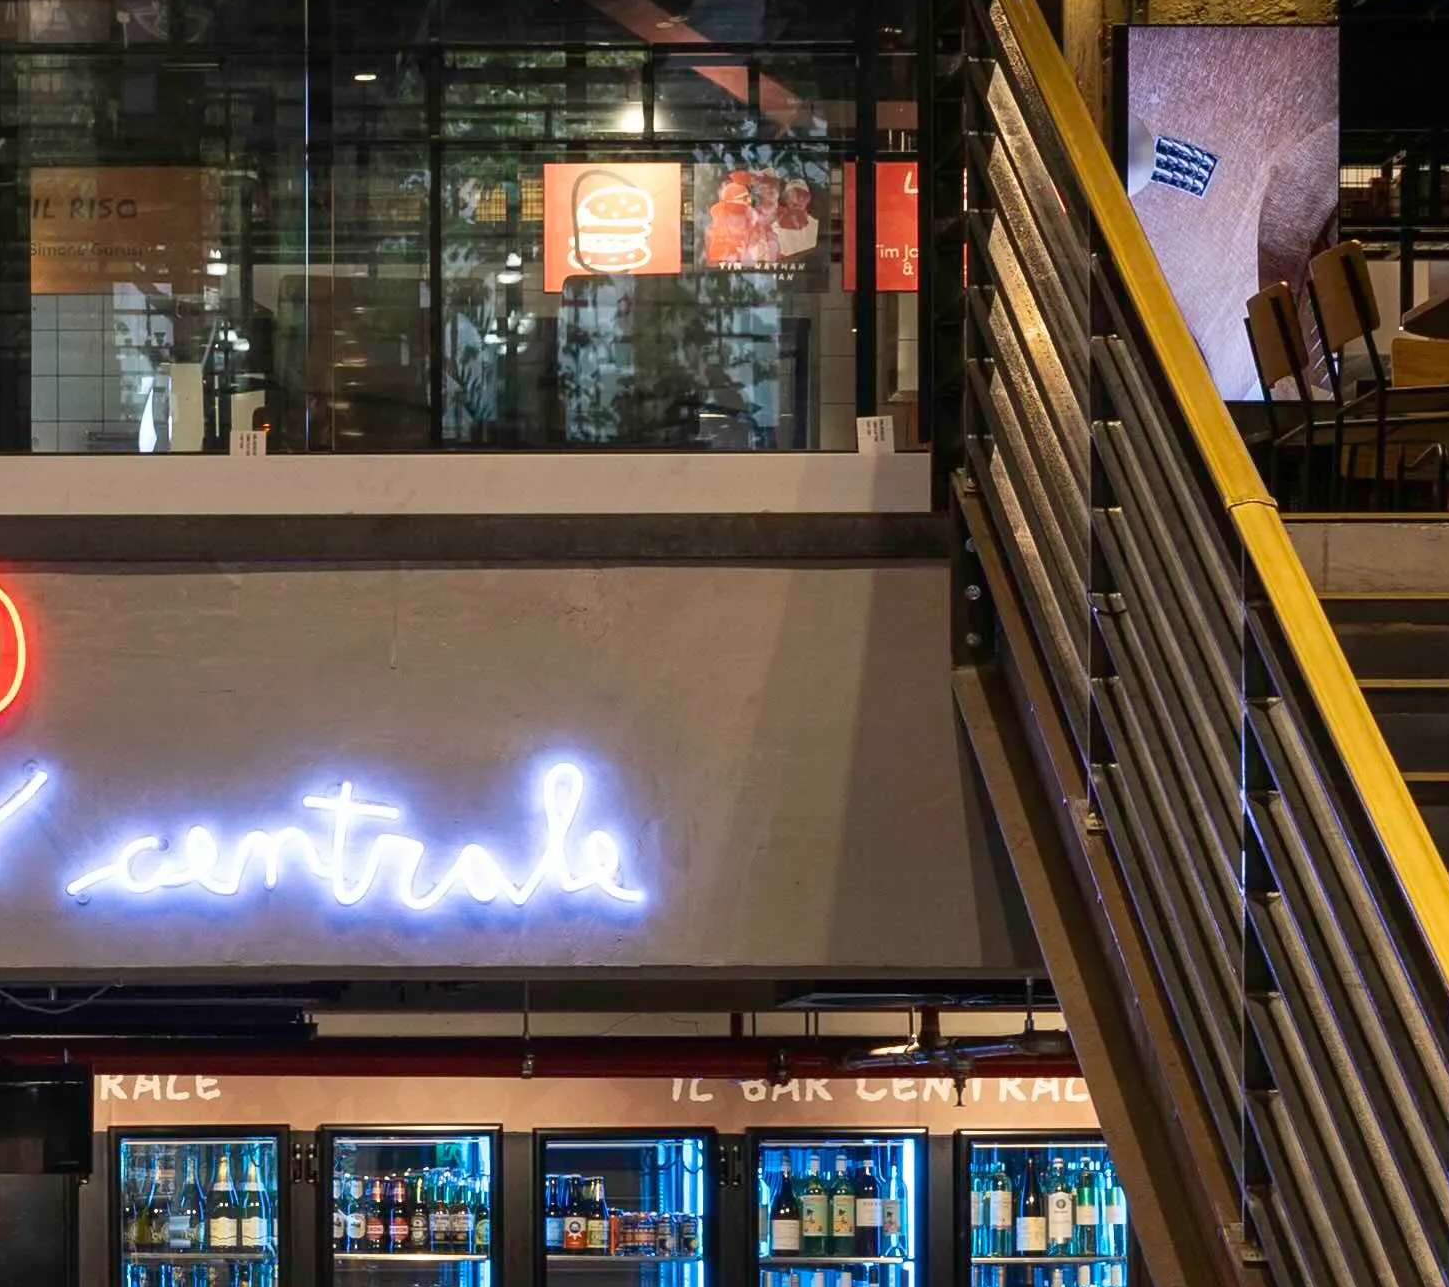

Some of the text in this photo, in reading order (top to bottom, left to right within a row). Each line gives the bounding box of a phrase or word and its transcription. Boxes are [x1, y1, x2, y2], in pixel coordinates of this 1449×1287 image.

[69, 198, 139, 220] RISO
[65, 760, 649, 911] centrale
[99, 1074, 223, 1101] RALE
[741, 1077, 834, 1103] BAR
[855, 1077, 1091, 1103] CENTRAL
